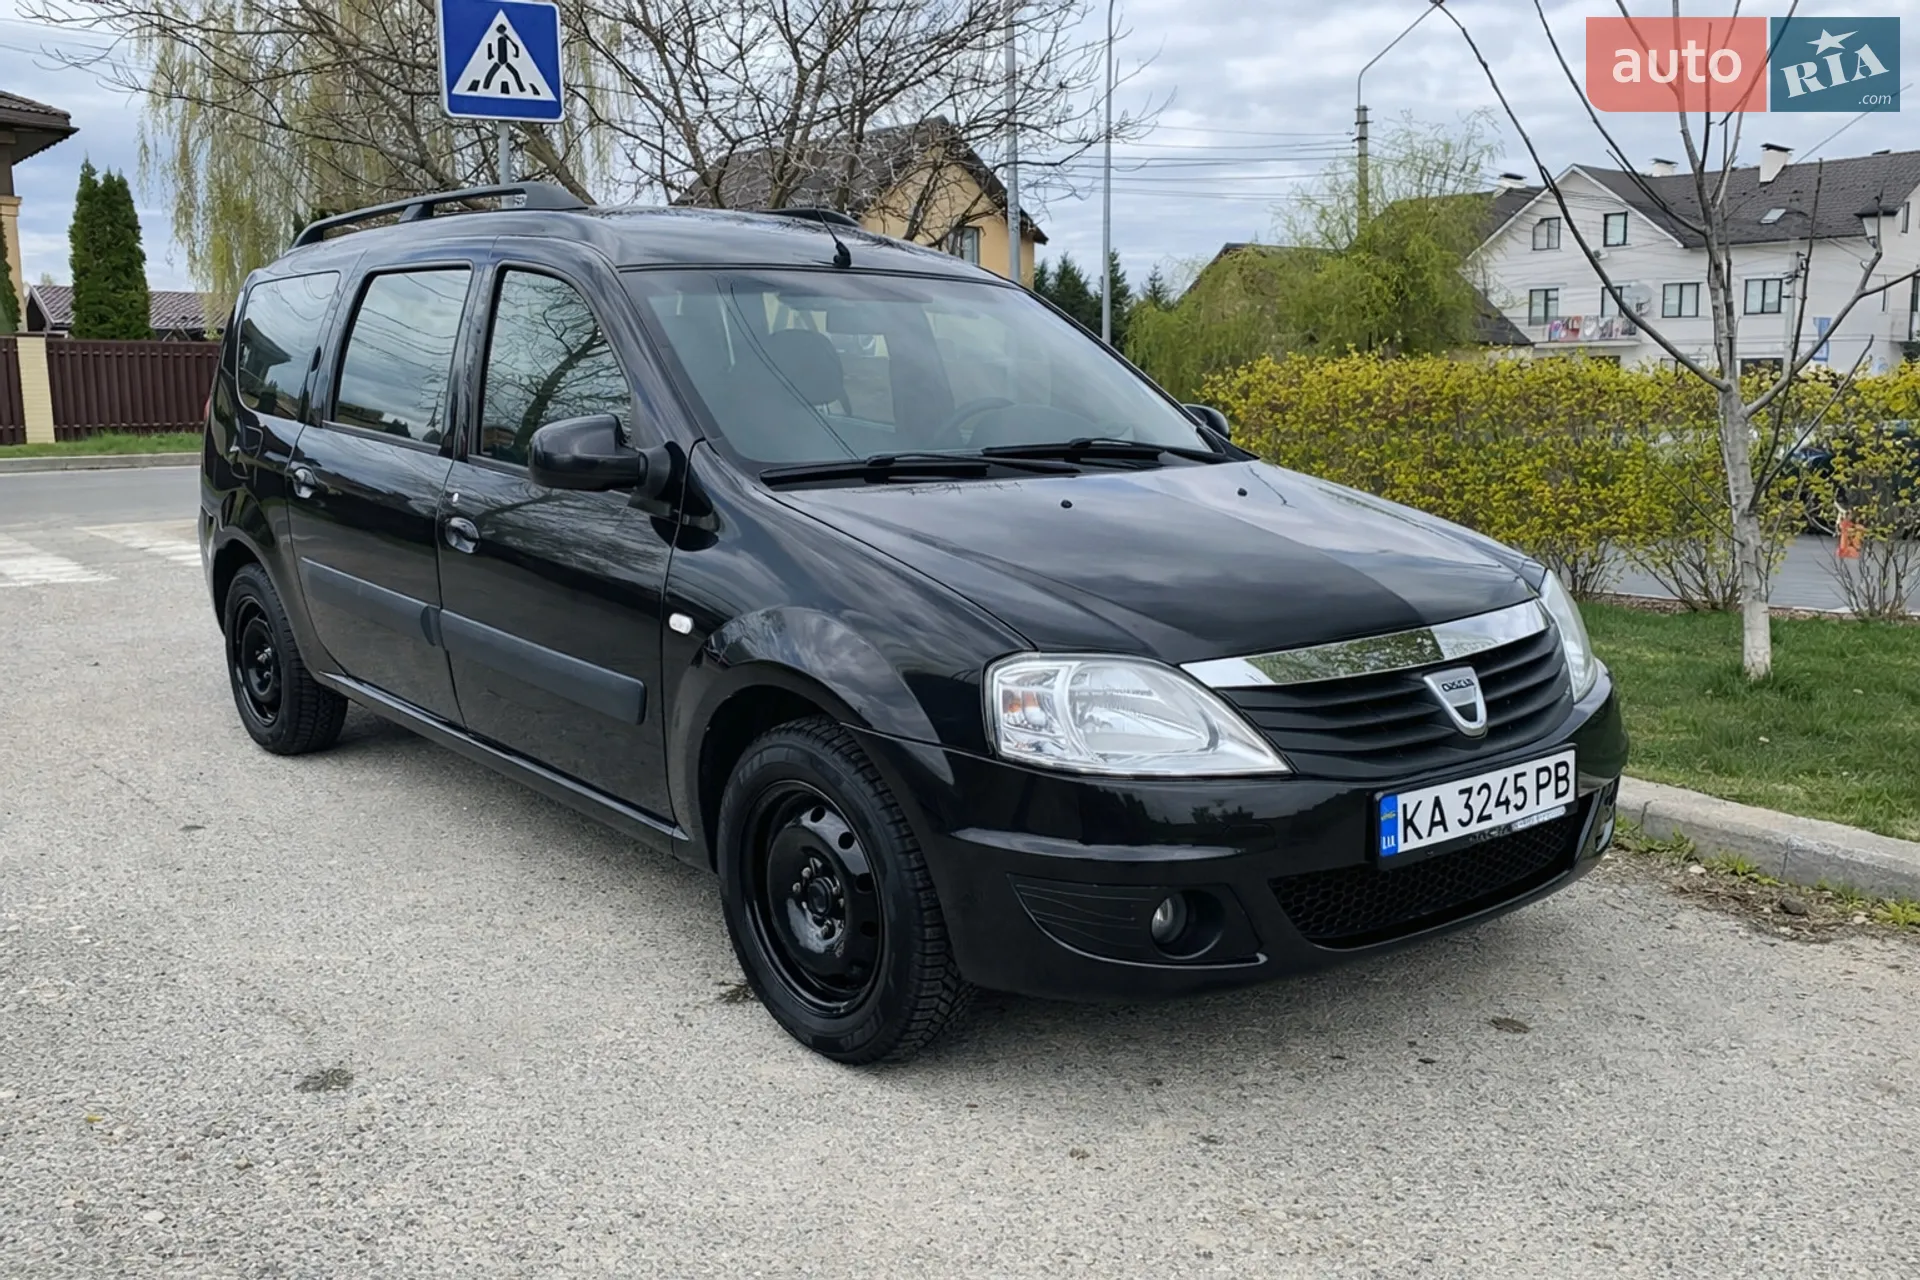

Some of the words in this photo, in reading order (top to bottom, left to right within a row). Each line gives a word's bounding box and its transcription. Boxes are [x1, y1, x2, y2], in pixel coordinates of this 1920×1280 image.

[1402, 796, 1449, 843] KA
[1457, 771, 1528, 828] 3245
[1535, 760, 1570, 806] PB
